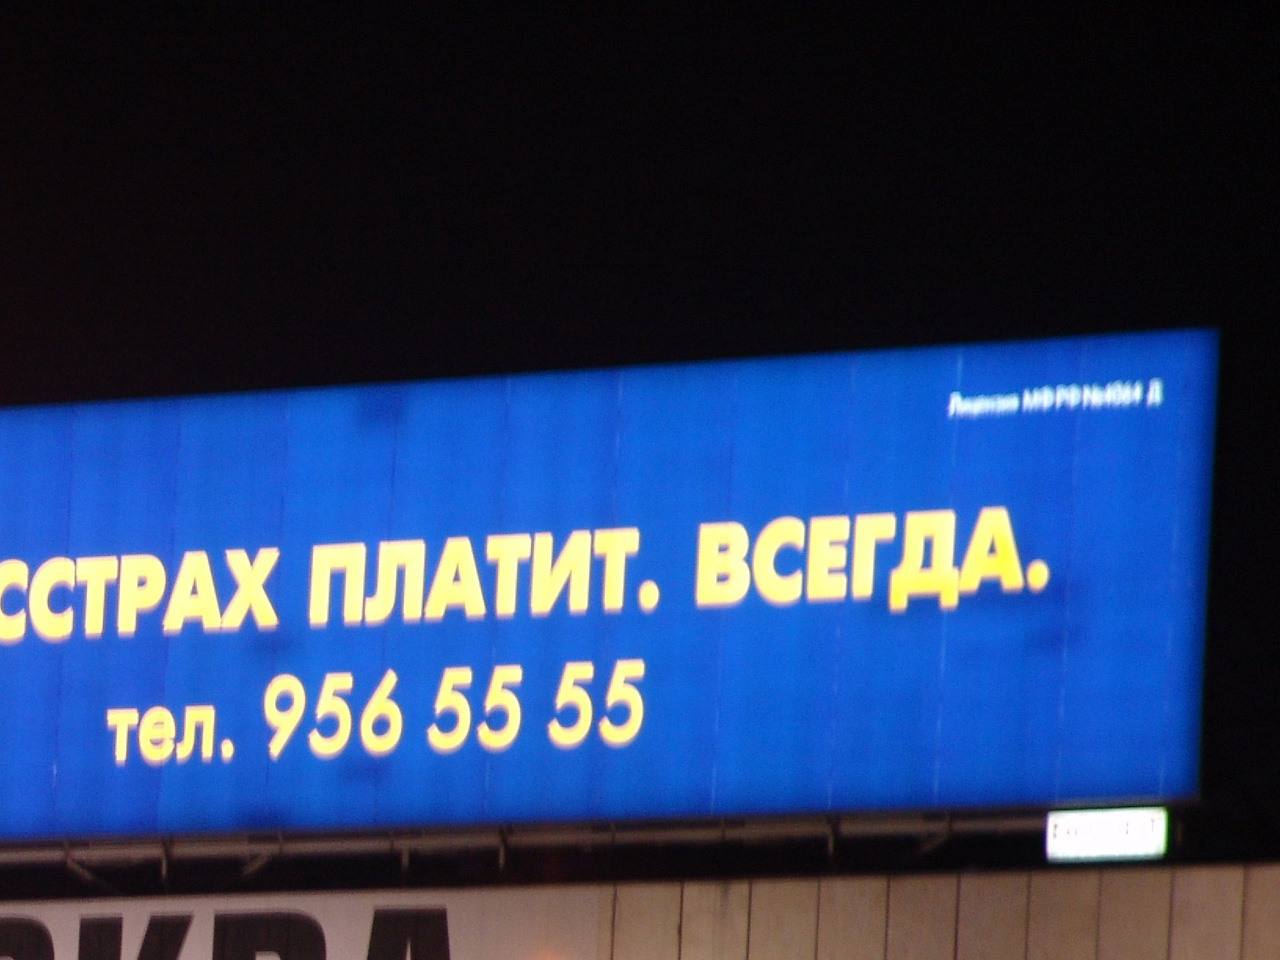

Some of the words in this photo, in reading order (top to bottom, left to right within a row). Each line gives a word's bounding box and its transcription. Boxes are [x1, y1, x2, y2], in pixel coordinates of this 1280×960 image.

[307, 527, 660, 631] ПЛАТИТ.
[695, 507, 1050, 612] ВСЕГДА.
[106, 705, 235, 766] тел.
[263, 670, 403, 762] 956
[426, 664, 523, 755] 55
[547, 659, 646, 749] 55
